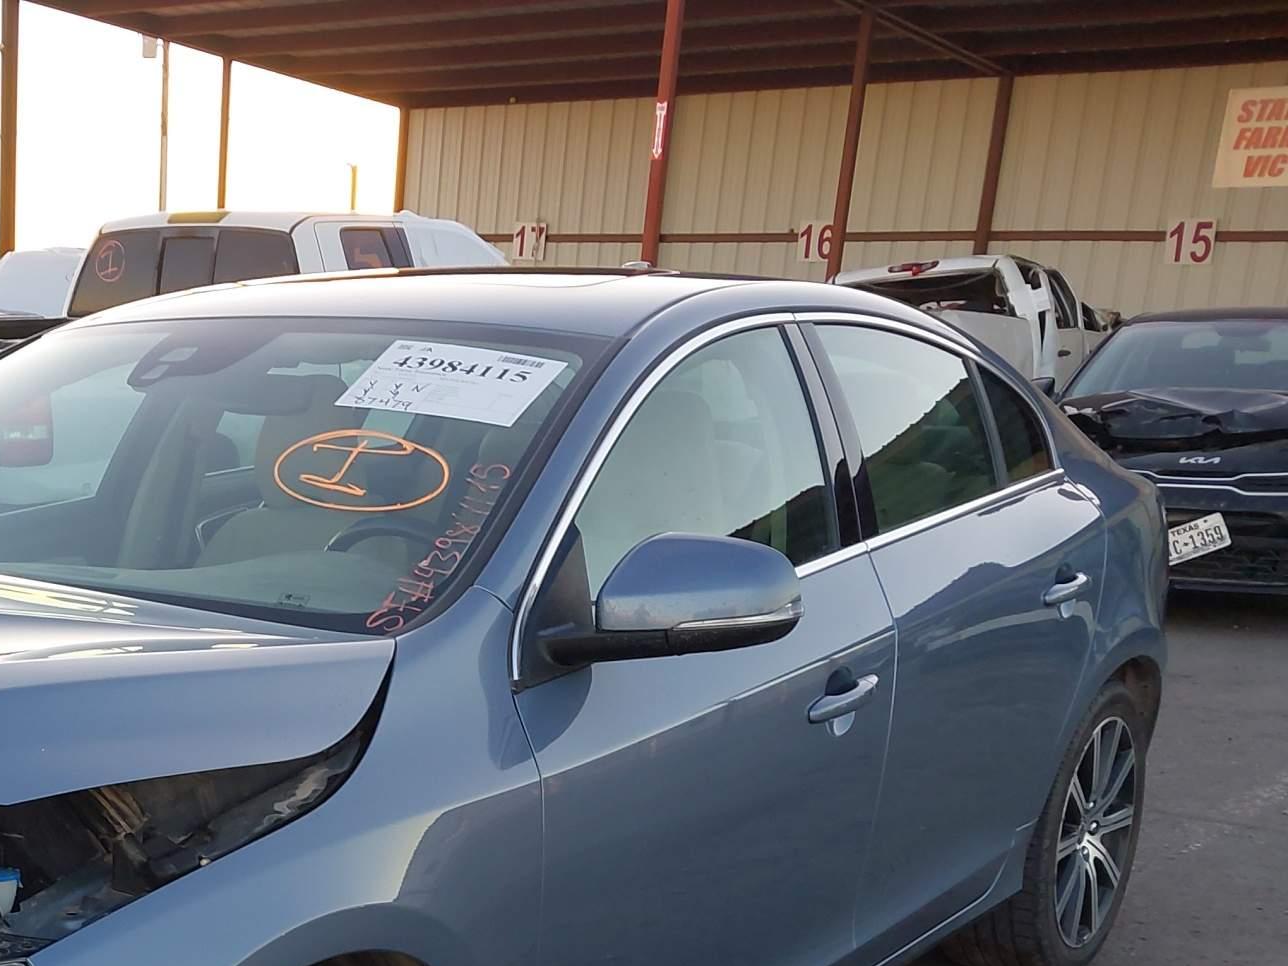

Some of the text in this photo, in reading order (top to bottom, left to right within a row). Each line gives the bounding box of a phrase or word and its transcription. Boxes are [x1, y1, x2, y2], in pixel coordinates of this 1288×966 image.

[1237, 98, 1288, 123] STA
[515, 225, 545, 257] 17
[800, 224, 833, 259] 16
[1169, 221, 1214, 262] 15
[393, 355, 532, 383] 43984115
[1171, 523, 1199, 537] TEXAS
